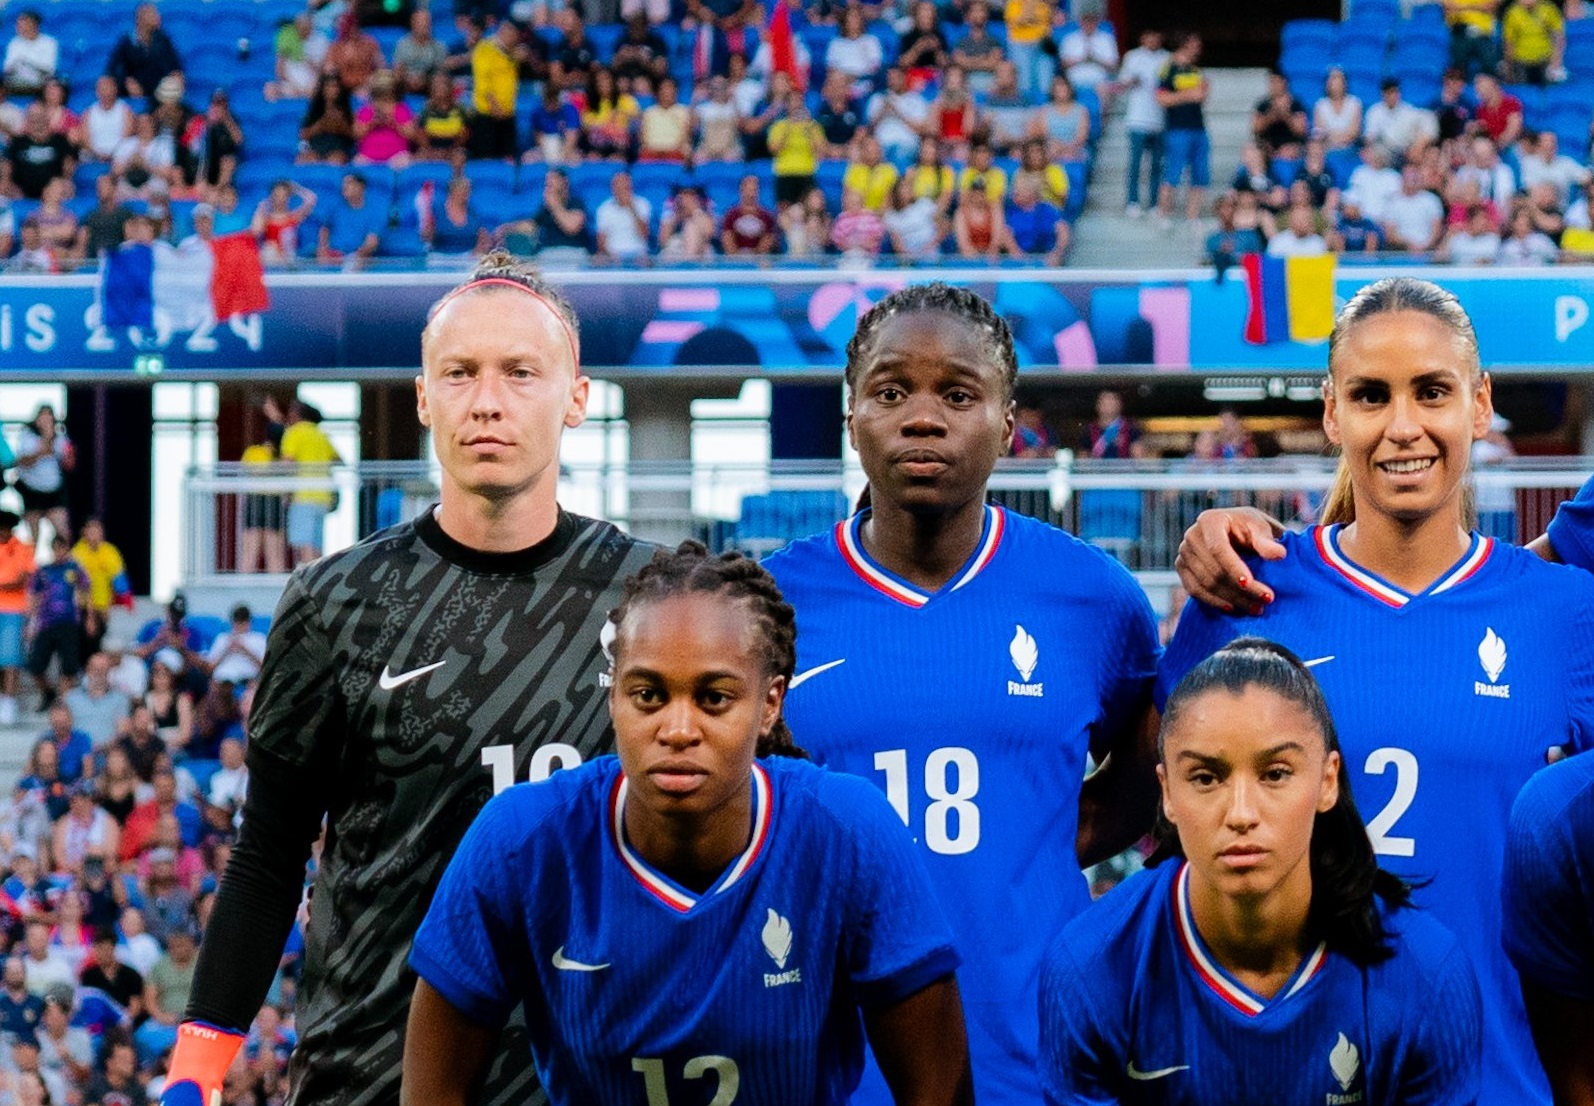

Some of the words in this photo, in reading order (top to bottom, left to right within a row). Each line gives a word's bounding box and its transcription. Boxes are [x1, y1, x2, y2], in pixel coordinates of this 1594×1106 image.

[1008, 680, 1043, 697] FRANCE
[1475, 681, 1510, 698] FRANCE
[873, 746, 981, 855] 18
[1364, 747, 1419, 857] 2
[763, 967, 802, 988] FRANCE
[1326, 1090, 1362, 1106] FRANCE
